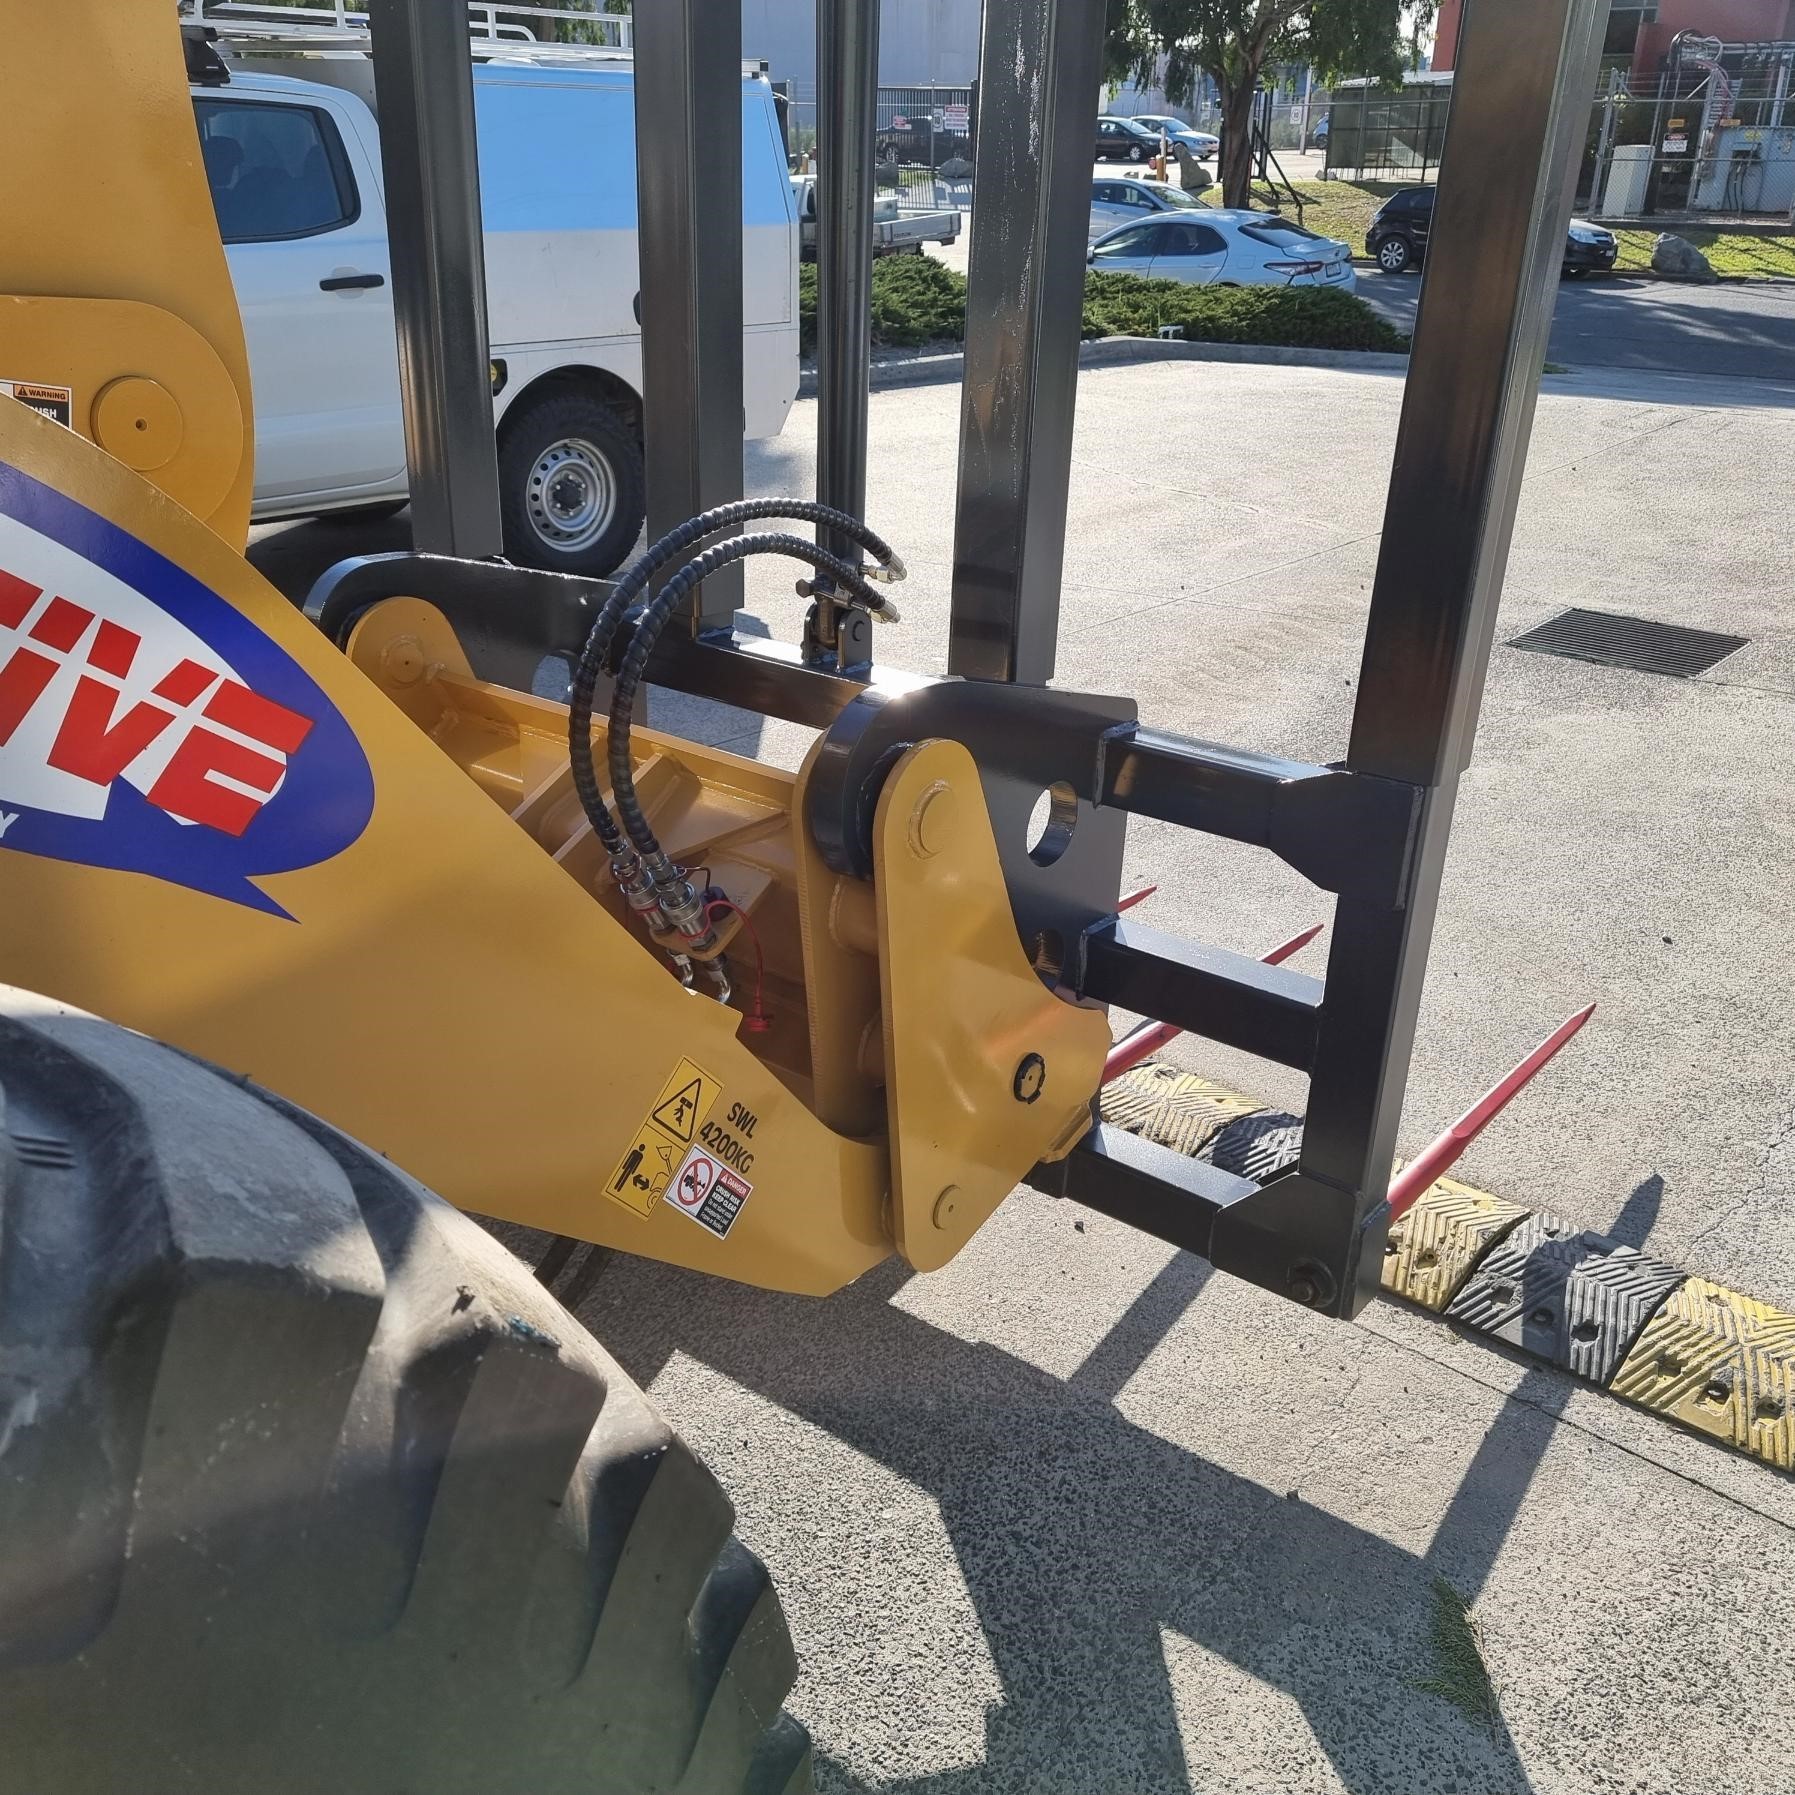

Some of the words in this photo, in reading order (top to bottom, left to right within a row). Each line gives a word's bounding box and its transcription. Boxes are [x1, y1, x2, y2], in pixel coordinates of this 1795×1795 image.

[28, 388, 66, 400] WARNING
[0, 568, 315, 839] IVE
[727, 1102, 758, 1140] SWL
[700, 1121, 755, 1174] 4200KG
[715, 1184, 731, 1199] CRUSH
[729, 1194, 741, 1207] RISK
[727, 1177, 747, 1197] DANGER
[711, 1191, 725, 1203] KEEP
[722, 1199, 737, 1213] CLEAR
